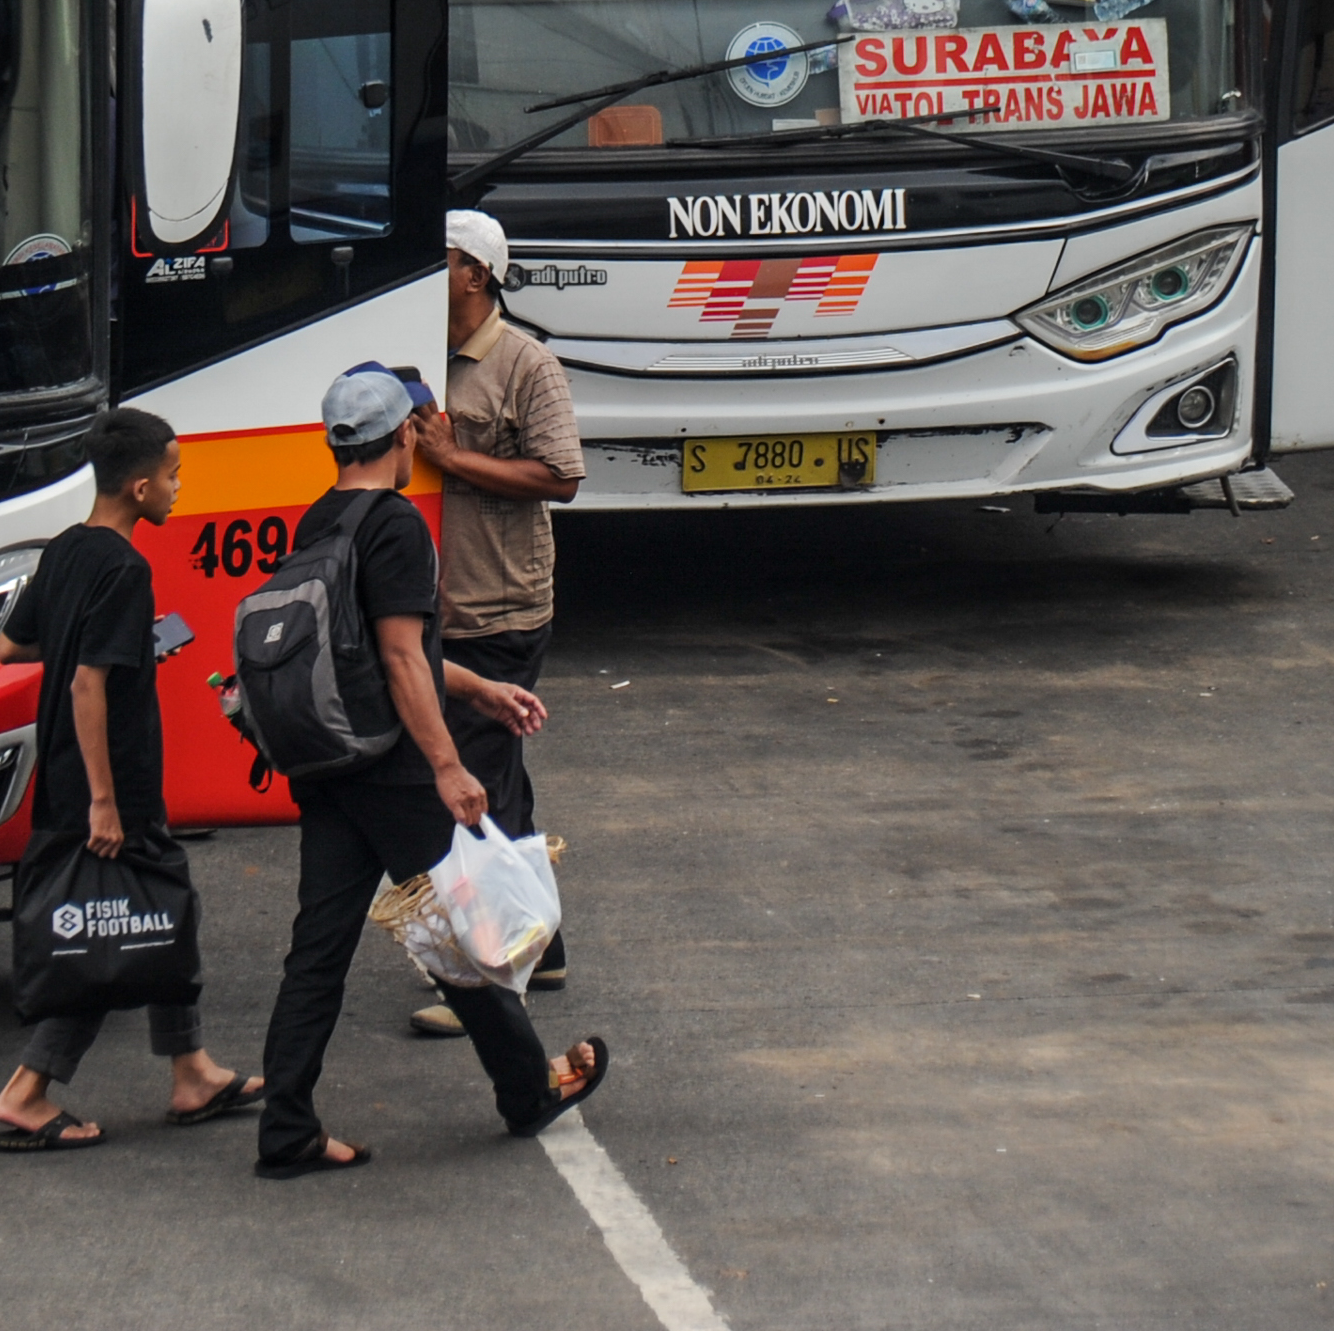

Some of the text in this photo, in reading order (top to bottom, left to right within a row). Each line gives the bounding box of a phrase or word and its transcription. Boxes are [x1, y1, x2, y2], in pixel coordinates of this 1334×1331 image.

[856, 93, 893, 116] VIA
[962, 85, 1065, 125] TRANS
[1073, 81, 1159, 119] JAWA
[667, 188, 908, 239] NON EKONOMI
[690, 437, 870, 473] S 7880 US
[85, 898, 131, 920] FISIK
[87, 912, 174, 938] FOOTBALL
